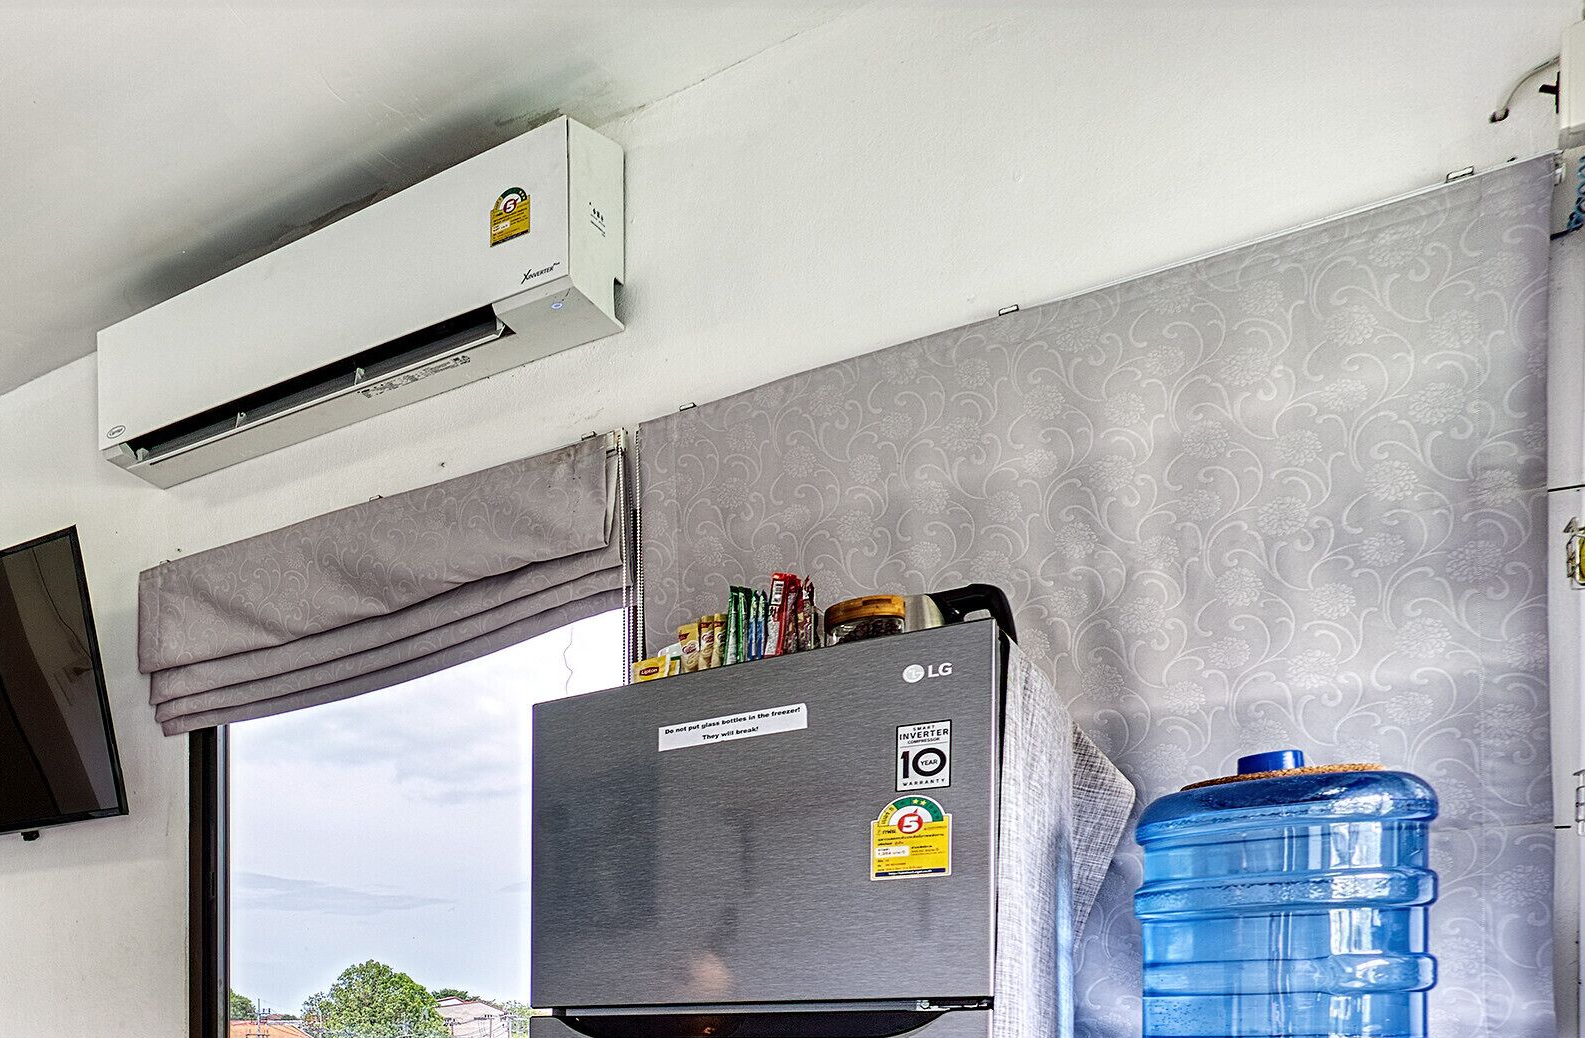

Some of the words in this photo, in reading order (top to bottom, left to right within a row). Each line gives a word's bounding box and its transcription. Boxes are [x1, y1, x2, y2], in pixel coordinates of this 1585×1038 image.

[927, 662, 953, 678] LG
[701, 721, 720, 730] glass
[722, 717, 747, 725] bottles
[771, 706, 801, 717] freezer!
[702, 732, 719, 740] They
[735, 726, 759, 735] break!
[899, 728, 949, 741] INVERTER
[912, 724, 936, 732] SMART
[900, 747, 947, 779] 10
[919, 758, 939, 767] YEAR
[902, 778, 946, 787] WARRANTY
[901, 815, 920, 833] 5
